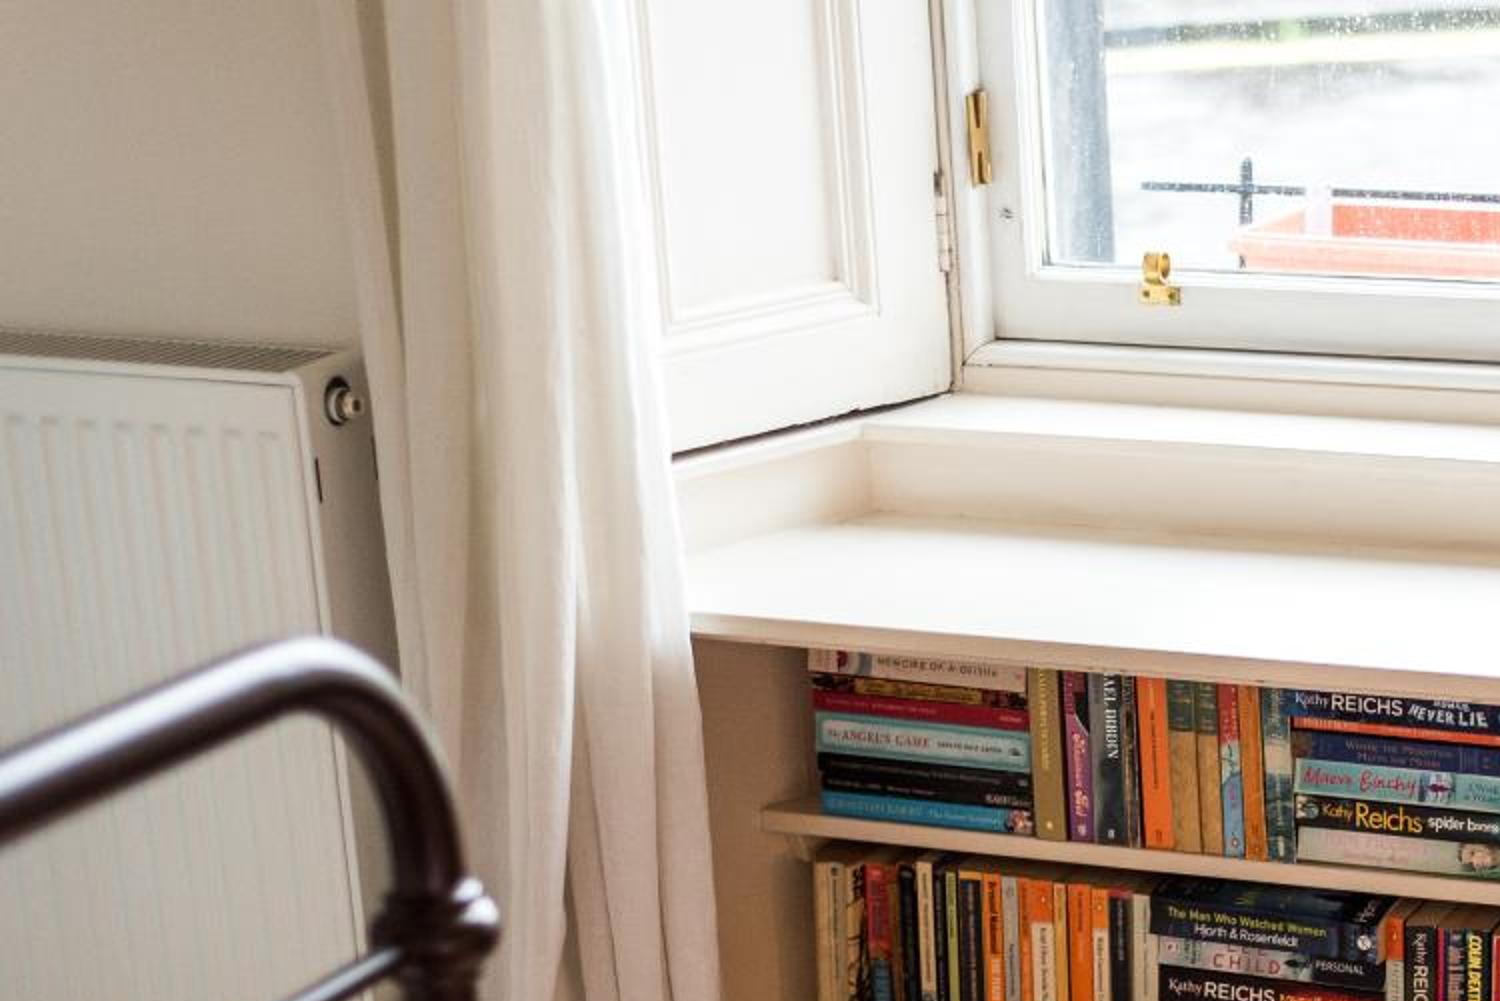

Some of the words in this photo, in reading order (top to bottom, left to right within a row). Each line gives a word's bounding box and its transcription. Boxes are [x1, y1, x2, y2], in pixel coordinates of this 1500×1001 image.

[1295, 692, 1329, 708] Kathy
[1331, 695, 1403, 717] REICHS
[1408, 704, 1456, 725] NEVER
[1459, 710, 1489, 728] LIE
[1355, 803, 1423, 833] Reichs
[1428, 816, 1465, 832] spider
[1467, 818, 1499, 834] bones
[1167, 906, 1188, 918] The
[1189, 908, 1211, 922] Man
[1214, 911, 1237, 925] Who
[1239, 914, 1285, 931] Watched
[1287, 921, 1327, 938] Women
[1229, 928, 1239, 940] &
[1413, 933, 1428, 965] Kathy
[1468, 935, 1482, 969] COLIN
[1213, 953, 1281, 975] CHILD
[1315, 960, 1365, 976] PERSONAL
[1168, 979, 1202, 996] Kathy
